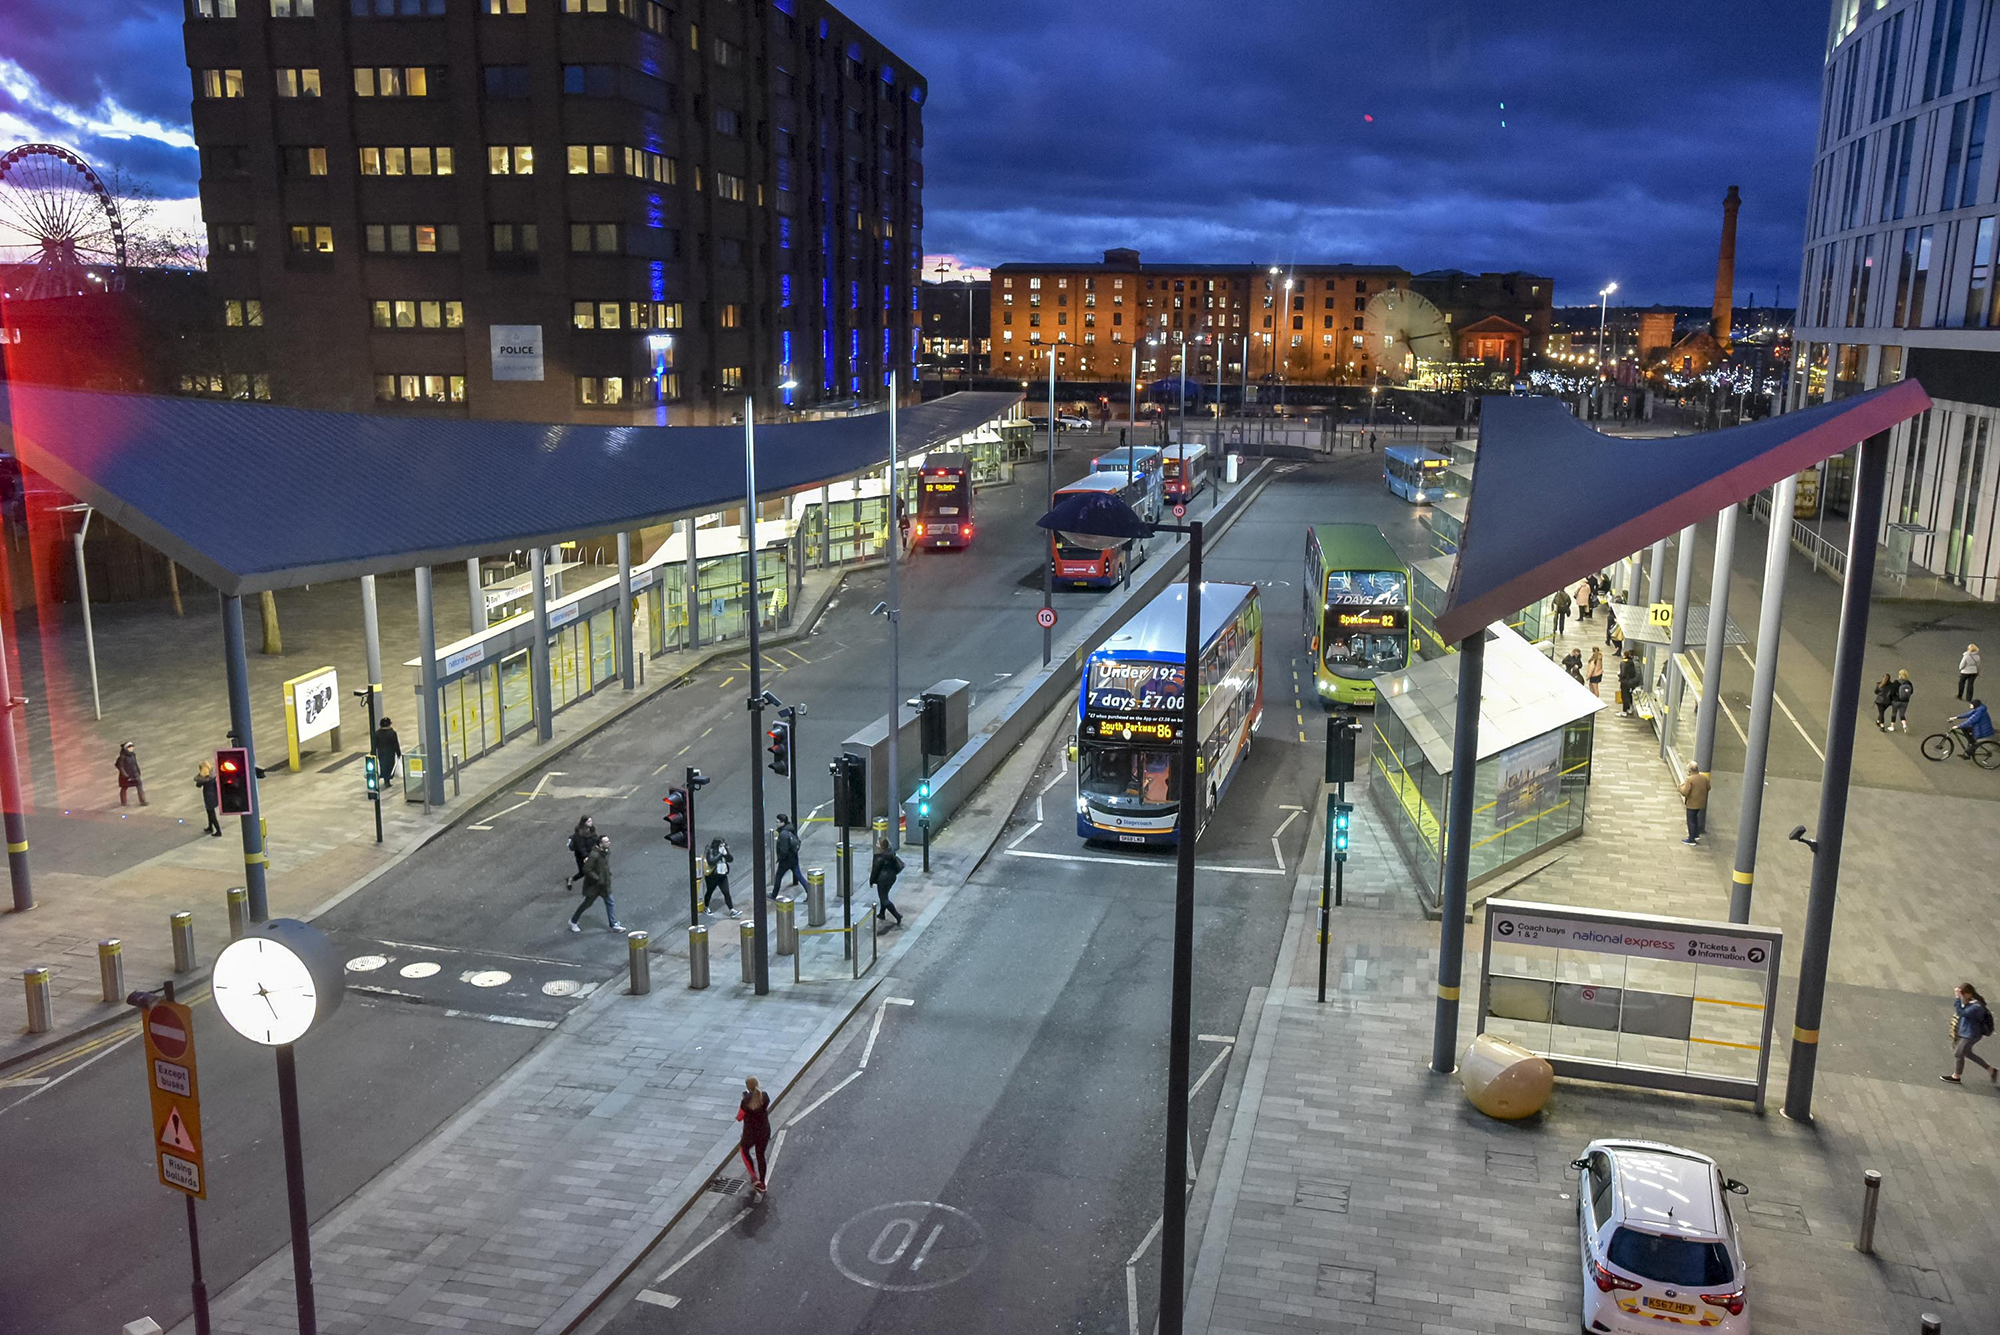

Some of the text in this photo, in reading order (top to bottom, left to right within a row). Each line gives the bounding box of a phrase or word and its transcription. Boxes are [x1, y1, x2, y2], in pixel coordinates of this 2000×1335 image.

[500, 345, 534, 355] POLICE
[1335, 595, 1342, 604] 7
[1342, 595, 1373, 605] DAYS
[1041, 613, 1052, 622] 10
[1381, 614, 1394, 627] 82
[1651, 609, 1670, 621] 10
[1100, 665, 1177, 681] Under 19?
[1088, 692, 1098, 705] 7
[1101, 692, 1136, 711] days
[1101, 721, 1124, 731] South
[1125, 722, 1157, 733] Parkway
[1157, 724, 1172, 738] 86
[1123, 819, 1153, 827] Stagecoach
[1518, 922, 1566, 935] Coach bays
[1572, 930, 1676, 950] national express
[1698, 941, 1729, 952] Tickets
[1697, 950, 1746, 961] Information
[158, 1064, 187, 1081] Except
[161, 1076, 185, 1091] buses
[168, 1158, 192, 1176] Rising
[165, 1169, 198, 1188] bollards
[1649, 1298, 1695, 1313] KS67 HFX
